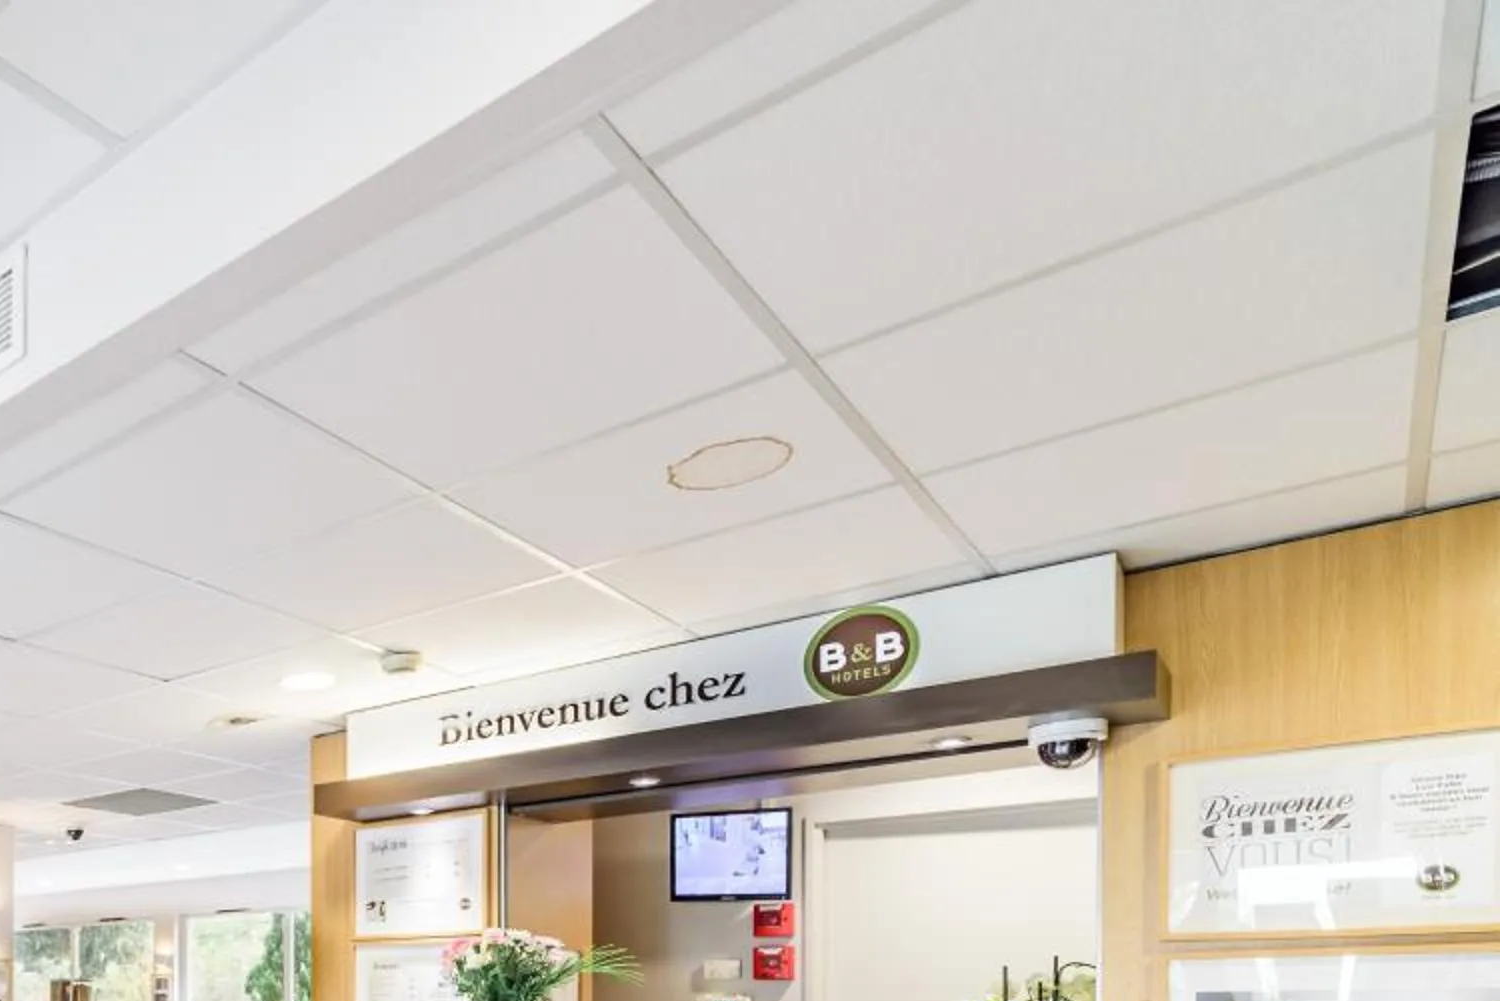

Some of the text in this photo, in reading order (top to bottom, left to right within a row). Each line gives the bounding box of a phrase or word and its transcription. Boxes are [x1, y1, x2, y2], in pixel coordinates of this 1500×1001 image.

[831, 663, 892, 685] HOTELS
[439, 671, 747, 747] Bienvenue chez
[1202, 794, 1353, 822] Bienvenue
